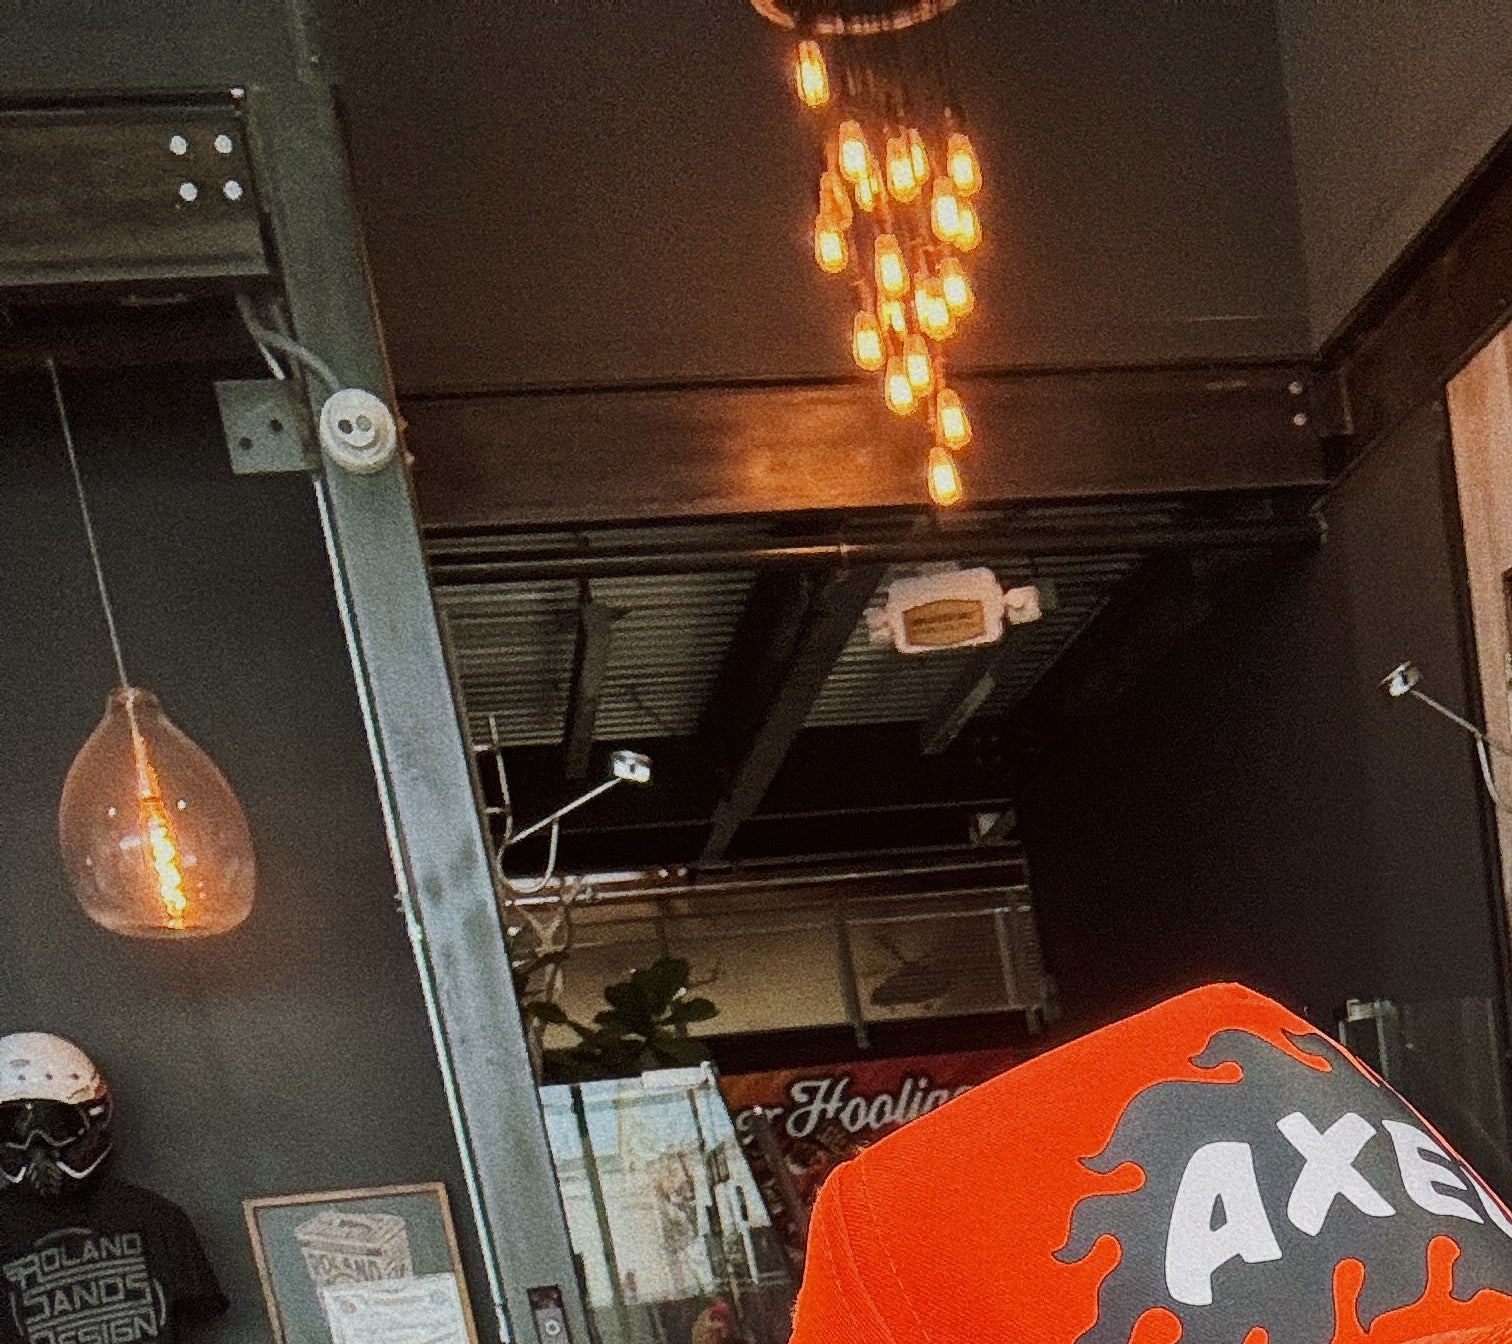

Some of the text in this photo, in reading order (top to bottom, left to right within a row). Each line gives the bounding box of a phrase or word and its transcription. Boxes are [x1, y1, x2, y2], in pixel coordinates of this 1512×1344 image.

[785, 1076, 974, 1138] Hooli
[2, 1232, 143, 1290] ROLAND
[22, 1271, 153, 1325] SANDS
